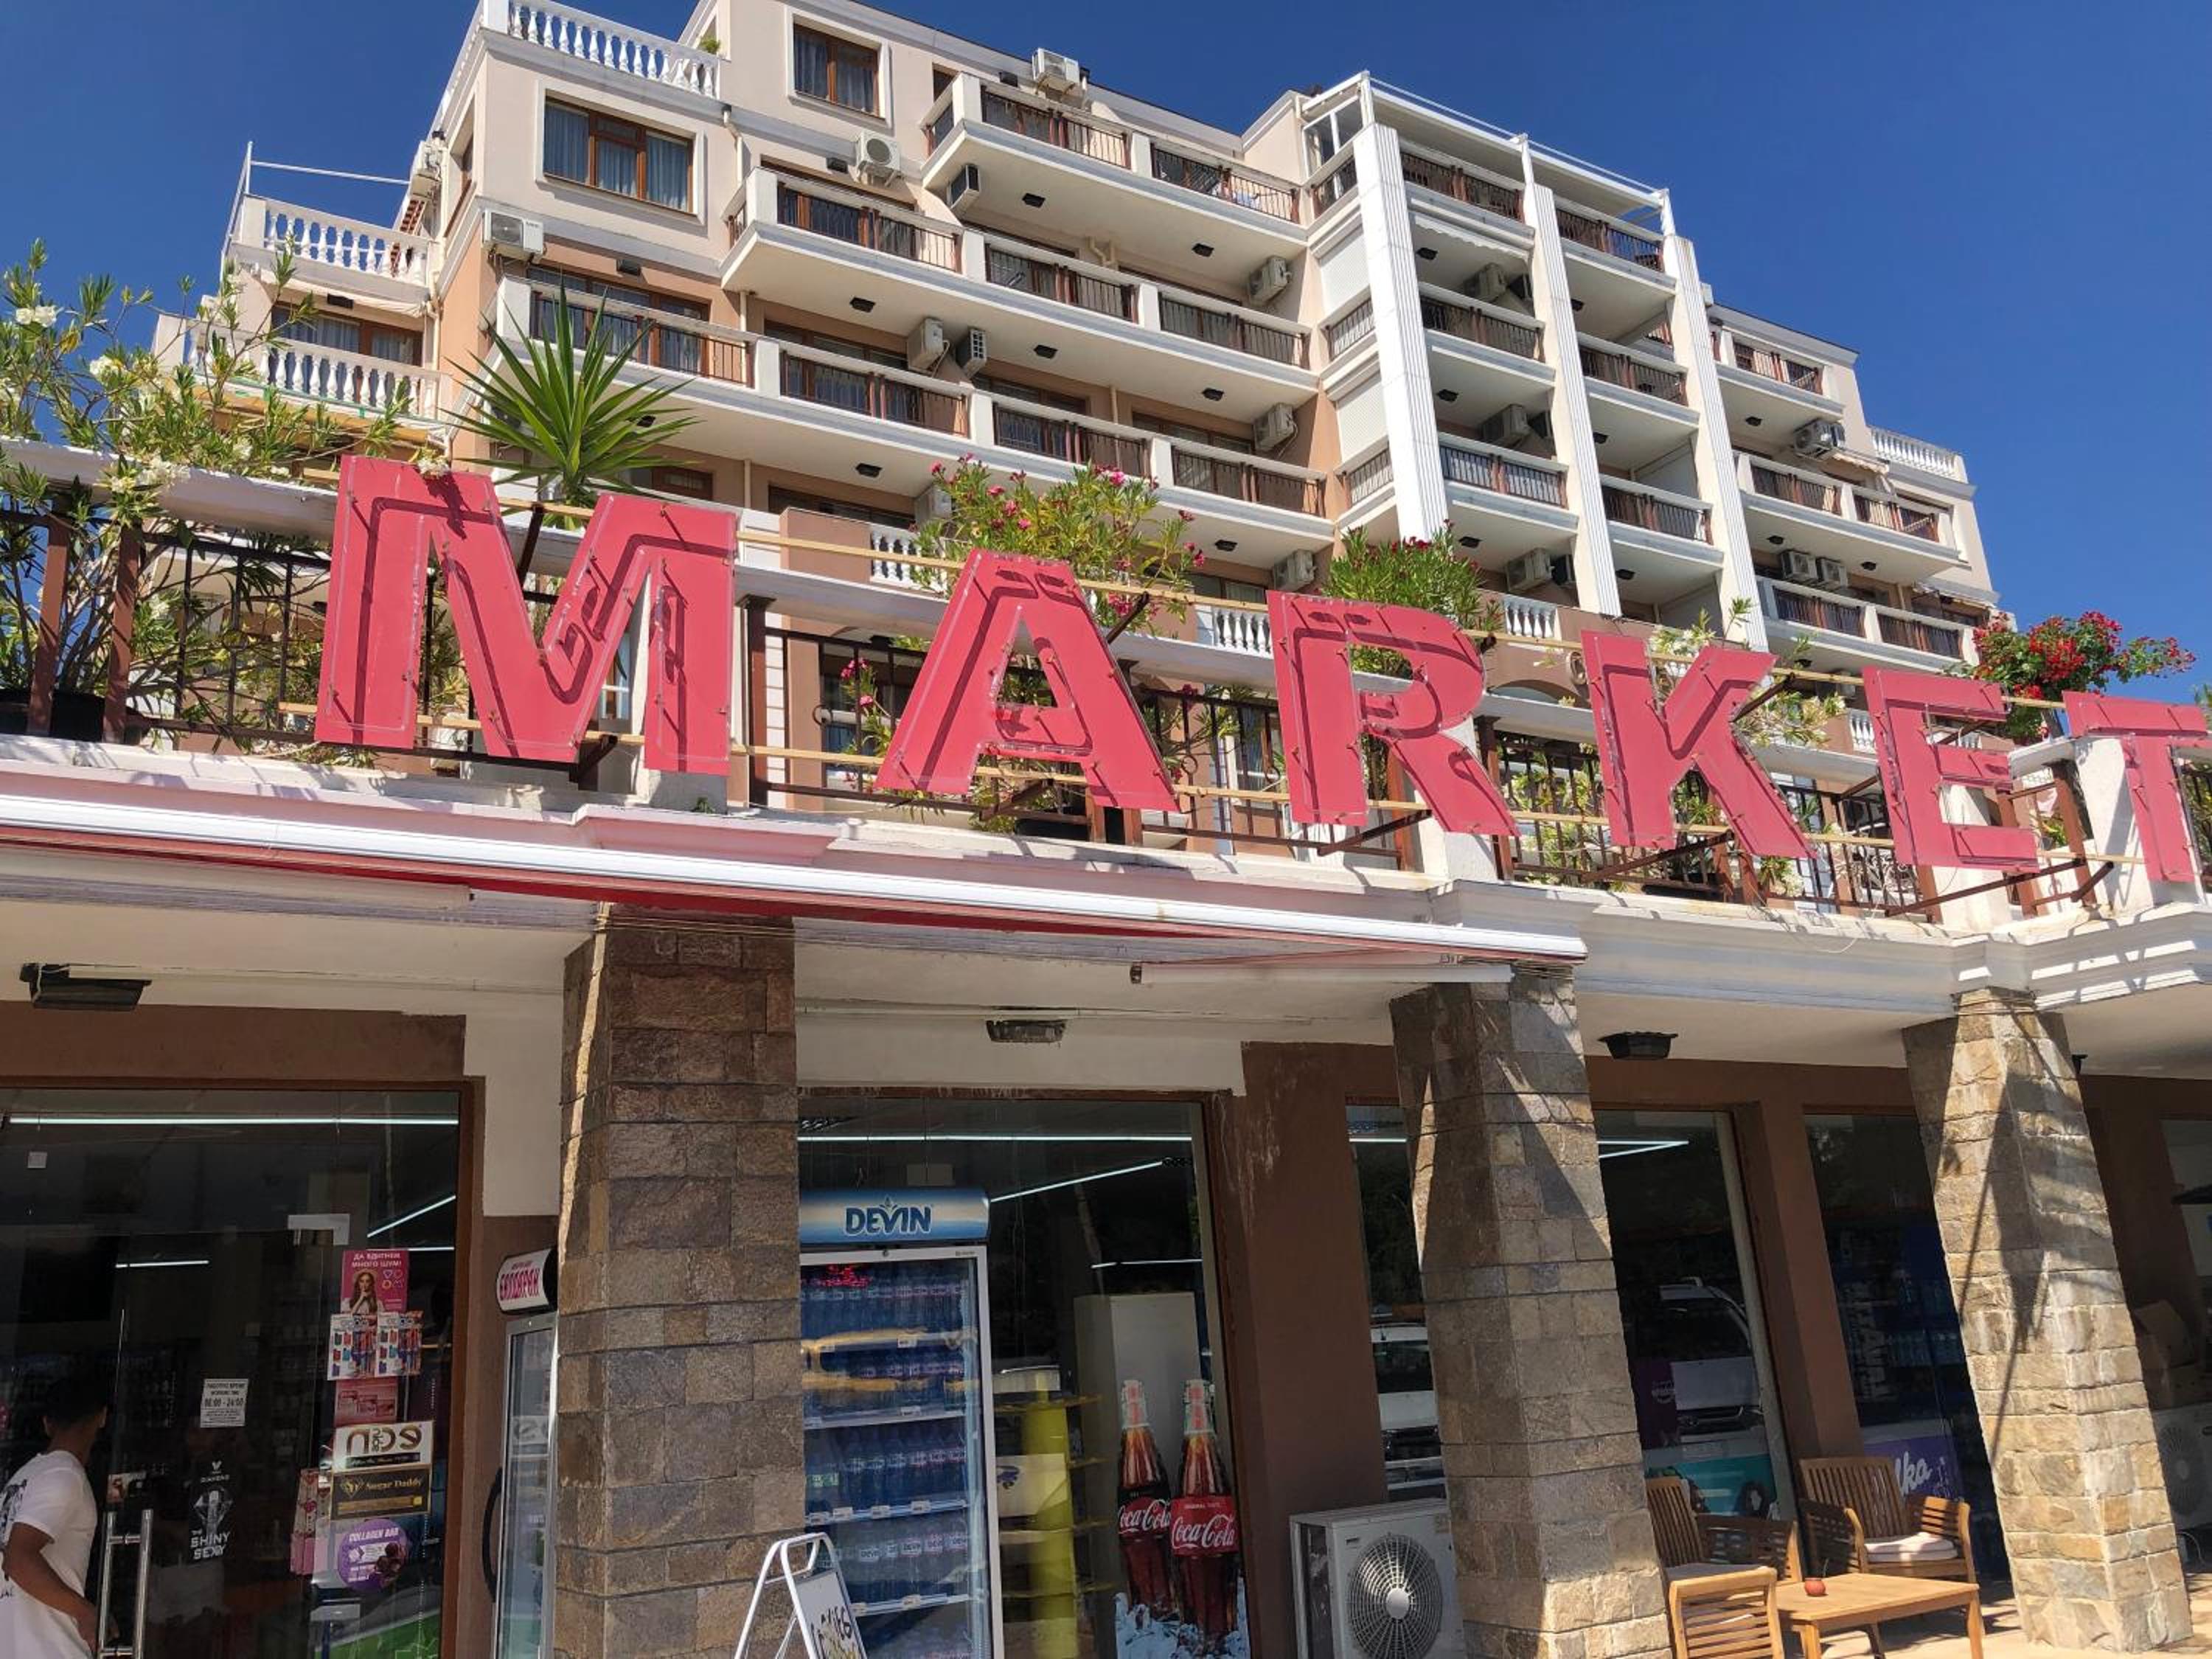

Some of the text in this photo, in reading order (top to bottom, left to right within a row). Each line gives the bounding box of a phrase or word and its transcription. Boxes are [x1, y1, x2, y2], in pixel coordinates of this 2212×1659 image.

[316, 454, 2212, 883] MARKET
[845, 1206, 933, 1235] DEVIN
[191, 1531, 231, 1548] SHINY
[1171, 1514, 1236, 1549] Coca-Cola
